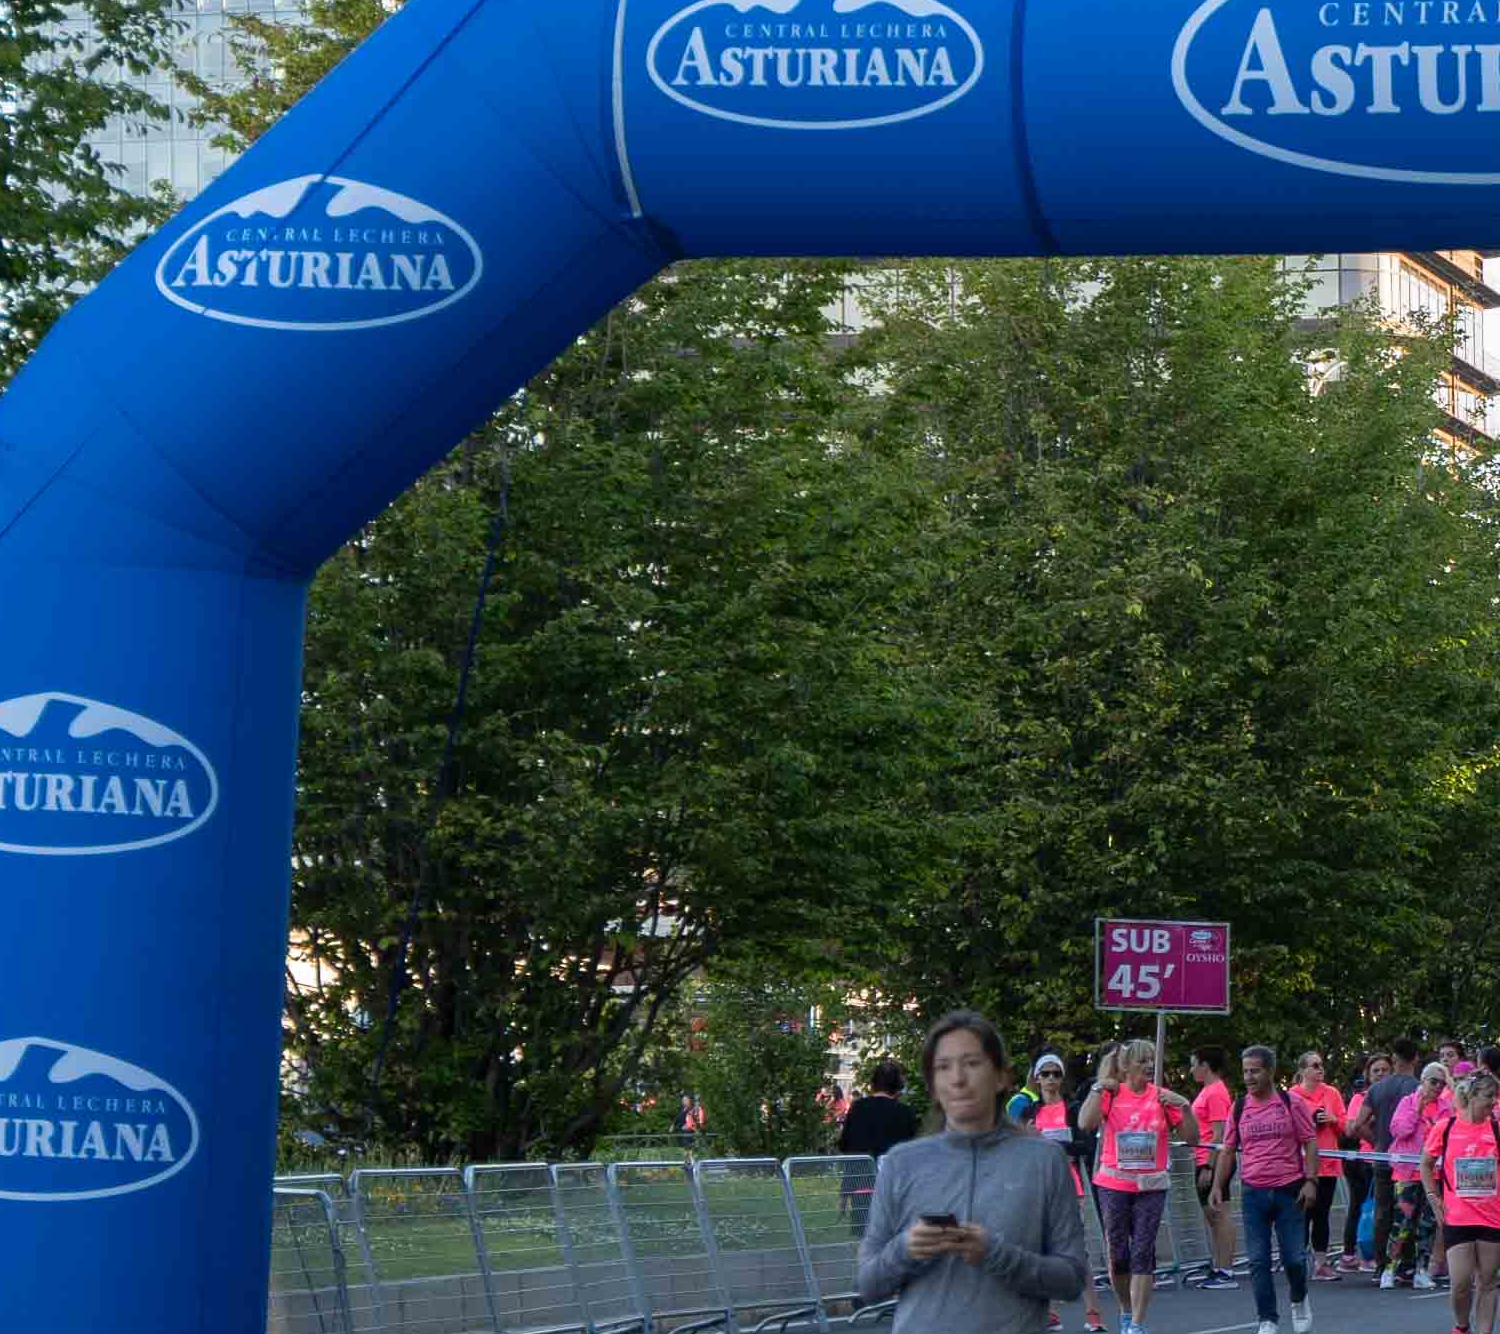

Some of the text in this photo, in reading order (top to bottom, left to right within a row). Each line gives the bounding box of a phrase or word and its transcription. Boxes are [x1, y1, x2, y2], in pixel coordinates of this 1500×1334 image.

[725, 24, 948, 38] CENTRAL LECHERA
[671, 27, 958, 87] ASTURIANA
[334, 228, 444, 245] LECHERA
[172, 235, 455, 291] ASTURIANA
[77, 750, 186, 769] LECHERA
[1112, 929, 1170, 954] SUB
[1186, 954, 1224, 963] OYSHO
[58, 1096, 165, 1113] LECHERA
